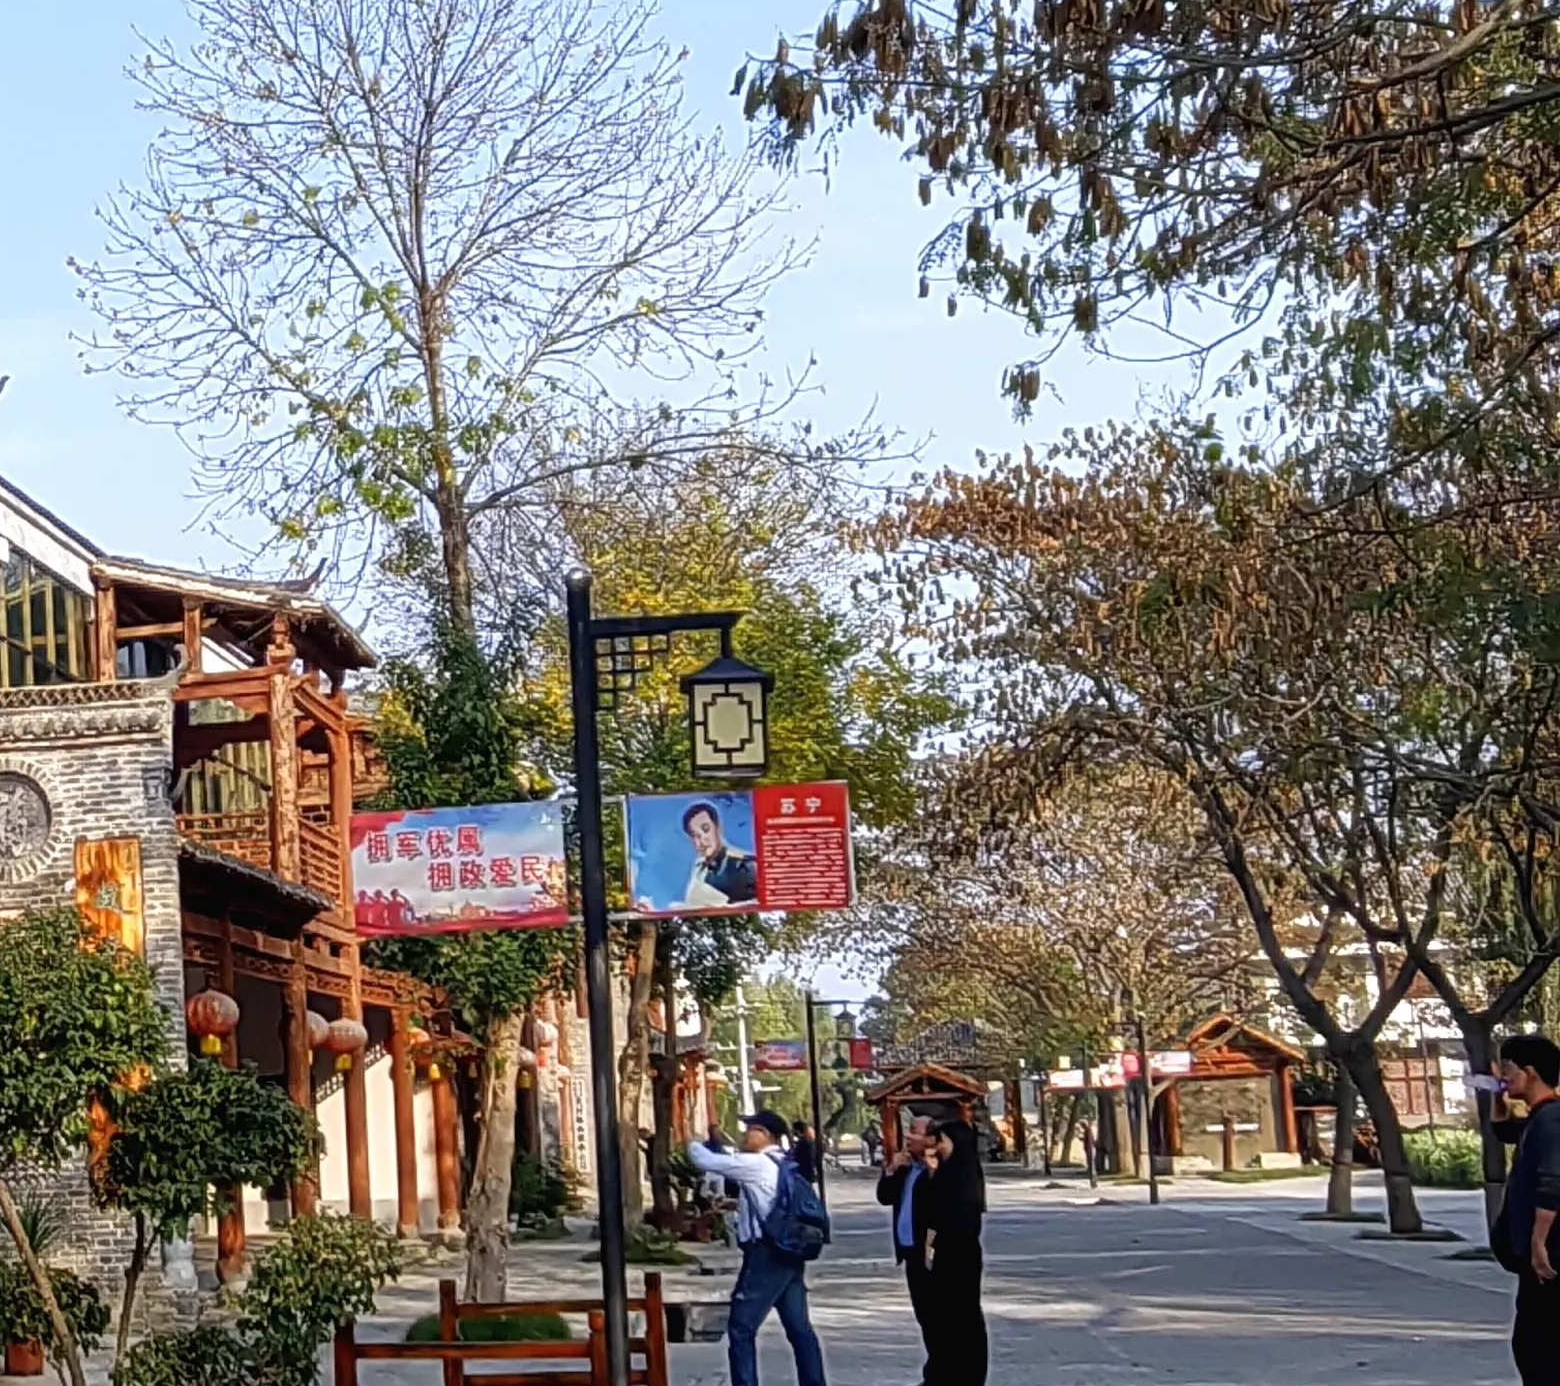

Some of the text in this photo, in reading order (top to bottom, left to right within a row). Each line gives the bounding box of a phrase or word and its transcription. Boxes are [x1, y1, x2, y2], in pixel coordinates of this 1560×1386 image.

[366, 825, 483, 863] 拥军优属
[427, 856, 544, 892] 拥政爱民
